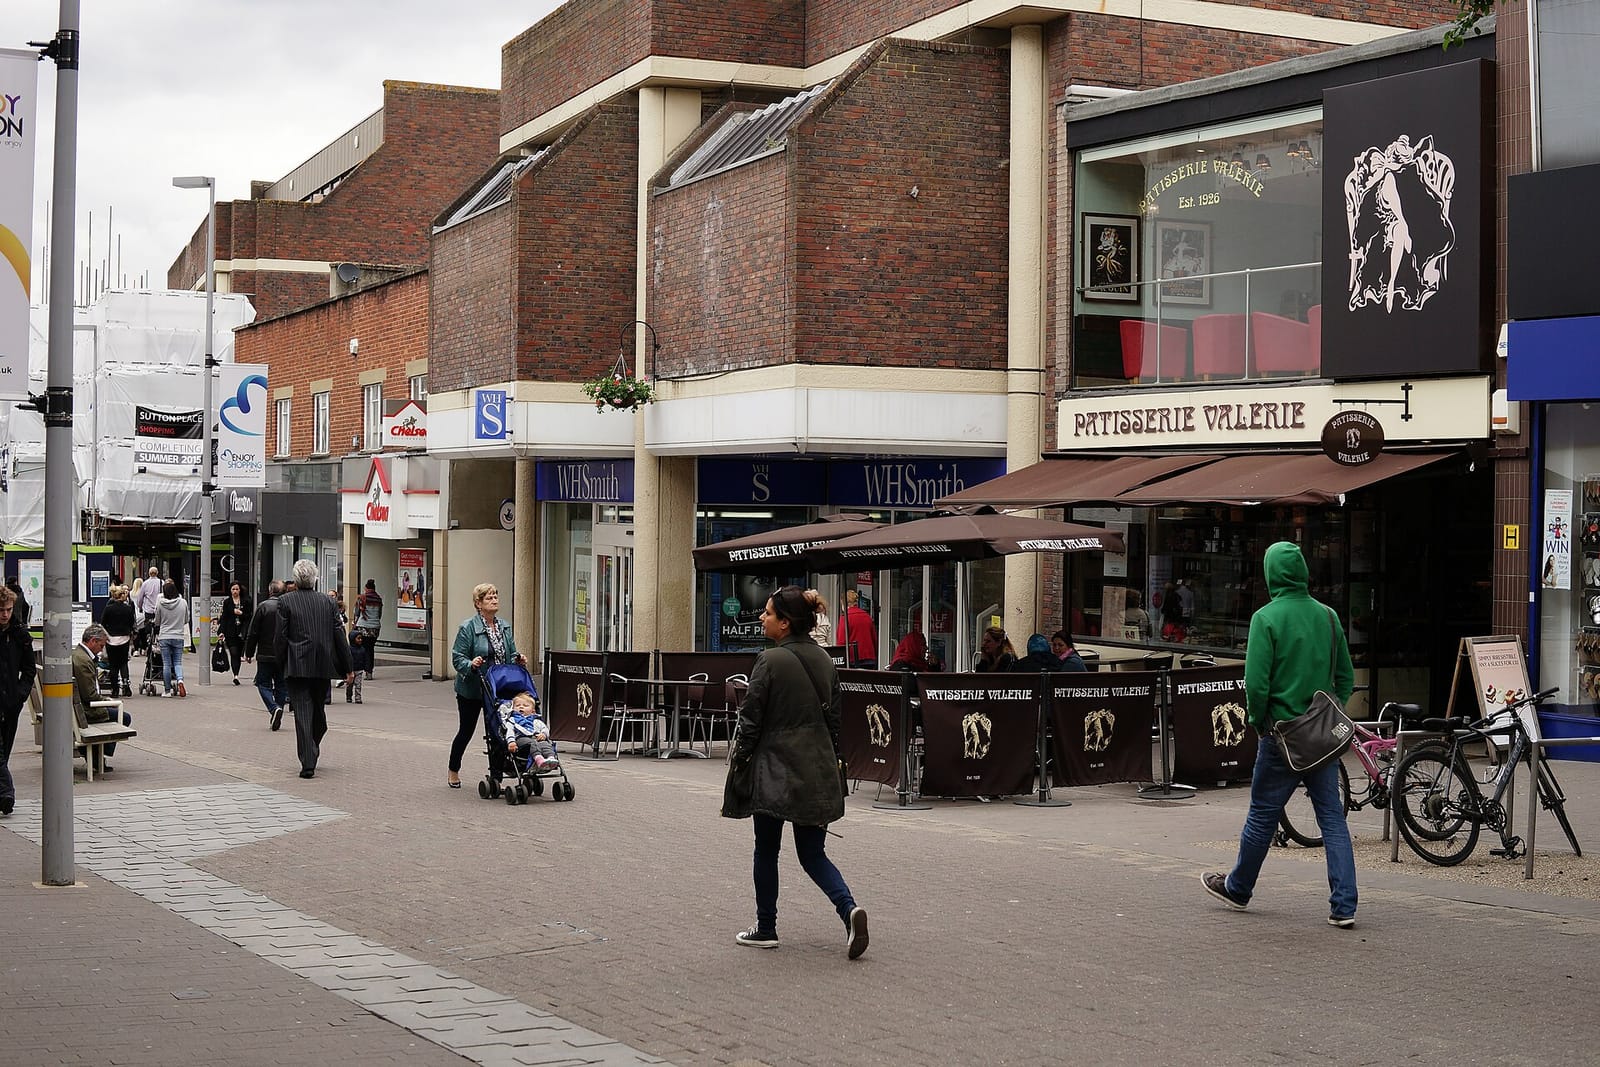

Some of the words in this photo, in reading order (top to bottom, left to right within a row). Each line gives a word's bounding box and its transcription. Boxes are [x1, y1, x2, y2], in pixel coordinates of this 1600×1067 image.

[1139, 160, 1208, 213] PATISSERIE
[1213, 159, 1264, 198] VALERIE
[1178, 196, 1196, 209] Est.
[1198, 192, 1221, 206] 1926
[482, 393, 502, 404] WH
[139, 411, 176, 423] SUTTON
[176, 414, 203, 423] PLACE
[481, 403, 503, 436] S
[1073, 406, 1196, 437] PATISSERIE
[1202, 401, 1306, 431] VALERIE
[1331, 413, 1376, 430] PATISSERIE
[139, 425, 175, 434] SHOPPING
[139, 442, 202, 453] COMPLETING
[138, 453, 179, 464] SUMMER
[181, 455, 202, 465] 2015
[1337, 451, 1370, 463] VALERIE
[228, 460, 263, 469] SHOPPING
[752, 463, 769, 473] WH
[557, 463, 620, 501] WHSmith
[752, 472, 770, 502] S
[863, 463, 964, 505] WHSmith
[1016, 539, 1066, 550] PATISSERIE
[1063, 537, 1103, 550] VALERIE
[1545, 540, 1569, 553] WIN
[728, 544, 790, 562] PATISSERIE
[840, 547, 903, 558] PATISSERIE
[901, 544, 952, 554] VALERIE
[722, 625, 751, 635] HALF
[584, 666, 603, 676] VALERI
[873, 684, 903, 695] VALERI
[1054, 687, 1110, 698] PATISSERIE
[1112, 685, 1150, 697] VALERIE
[1178, 680, 1235, 695] PATISSERIE
[925, 689, 985, 700] PATISSERIE
[987, 689, 1032, 700] VALERIE
